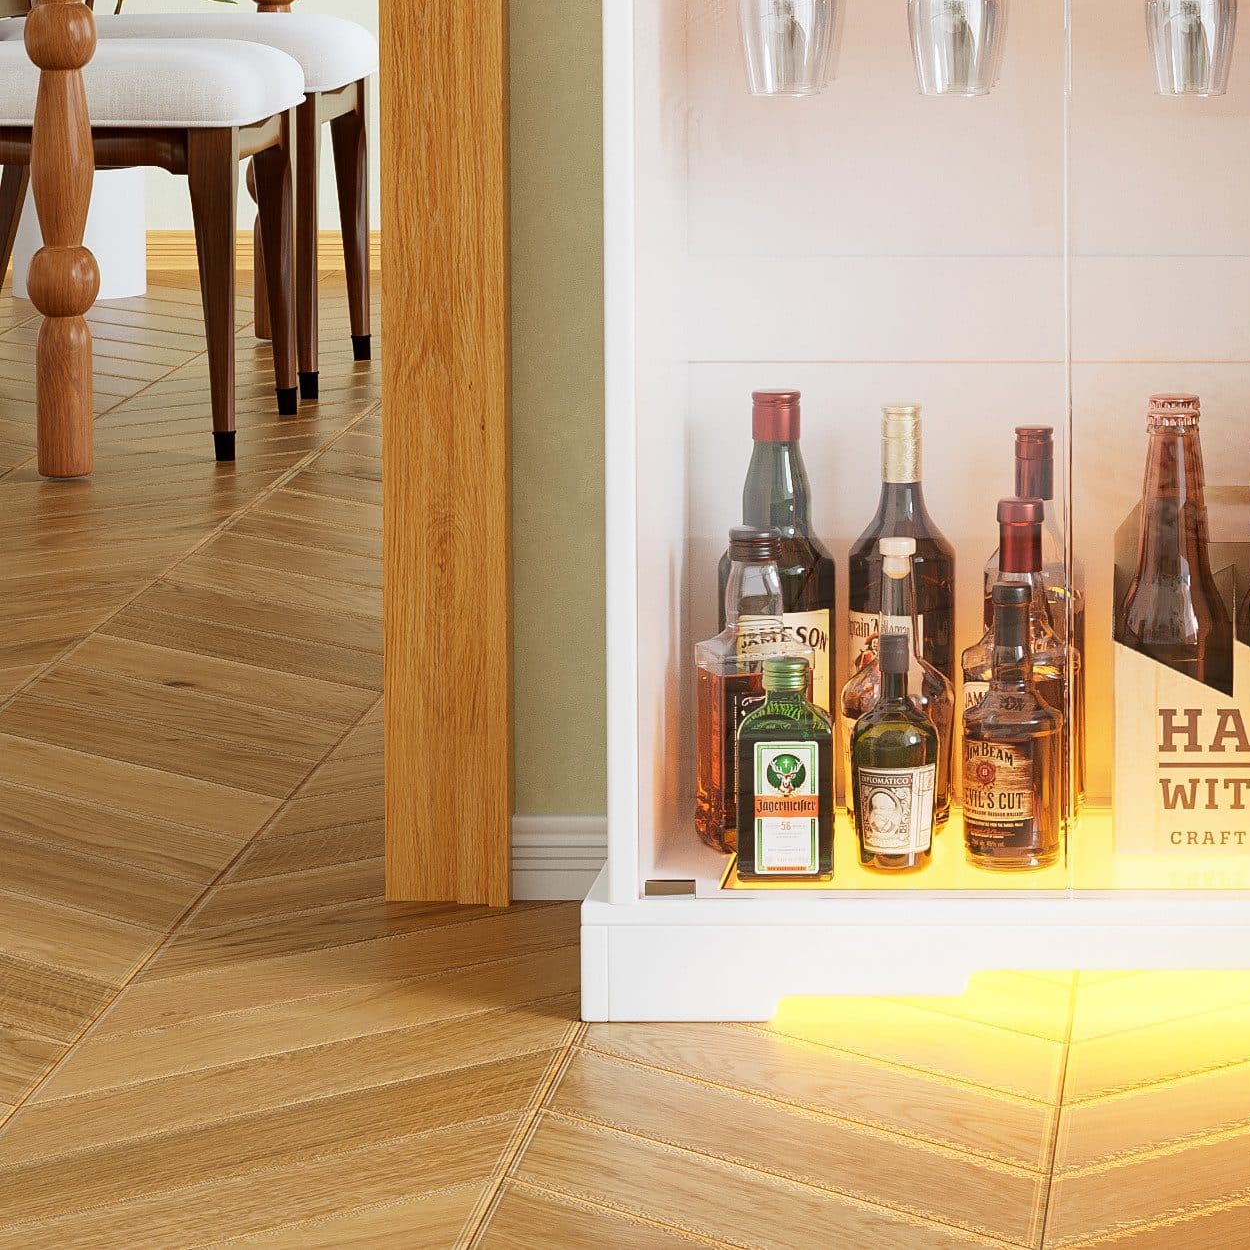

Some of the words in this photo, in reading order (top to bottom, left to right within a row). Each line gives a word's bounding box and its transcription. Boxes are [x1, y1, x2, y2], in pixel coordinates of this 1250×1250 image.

[981, 742, 1014, 767] BEAM
[999, 792, 1023, 809] CUT
[1170, 831, 1246, 845] CRAFT
